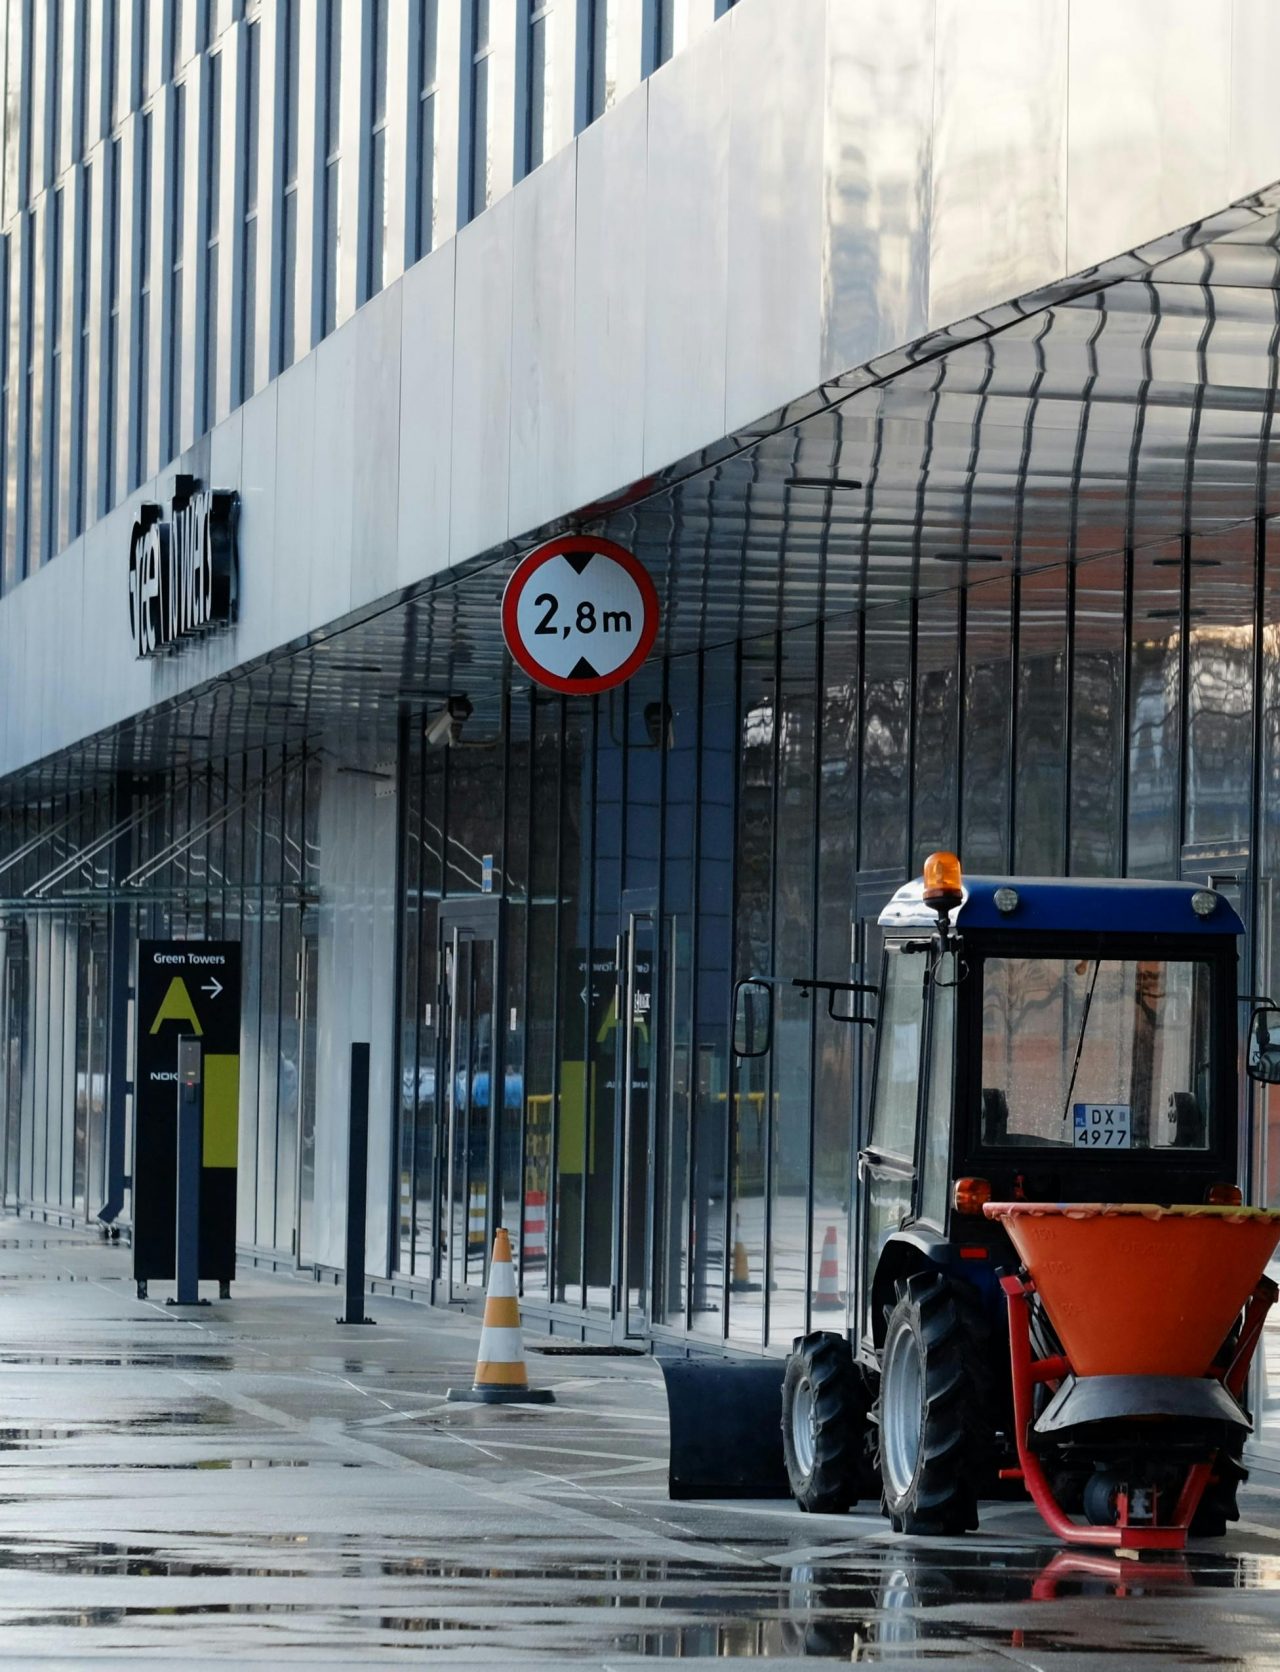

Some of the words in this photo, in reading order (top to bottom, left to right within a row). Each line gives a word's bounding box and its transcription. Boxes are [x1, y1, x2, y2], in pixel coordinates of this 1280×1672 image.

[153, 952, 186, 964] Green
[187, 953, 225, 965] Towers
[149, 976, 204, 1036] A
[1092, 1109, 1114, 1125] DX
[1078, 1129, 1127, 1146] 4977
